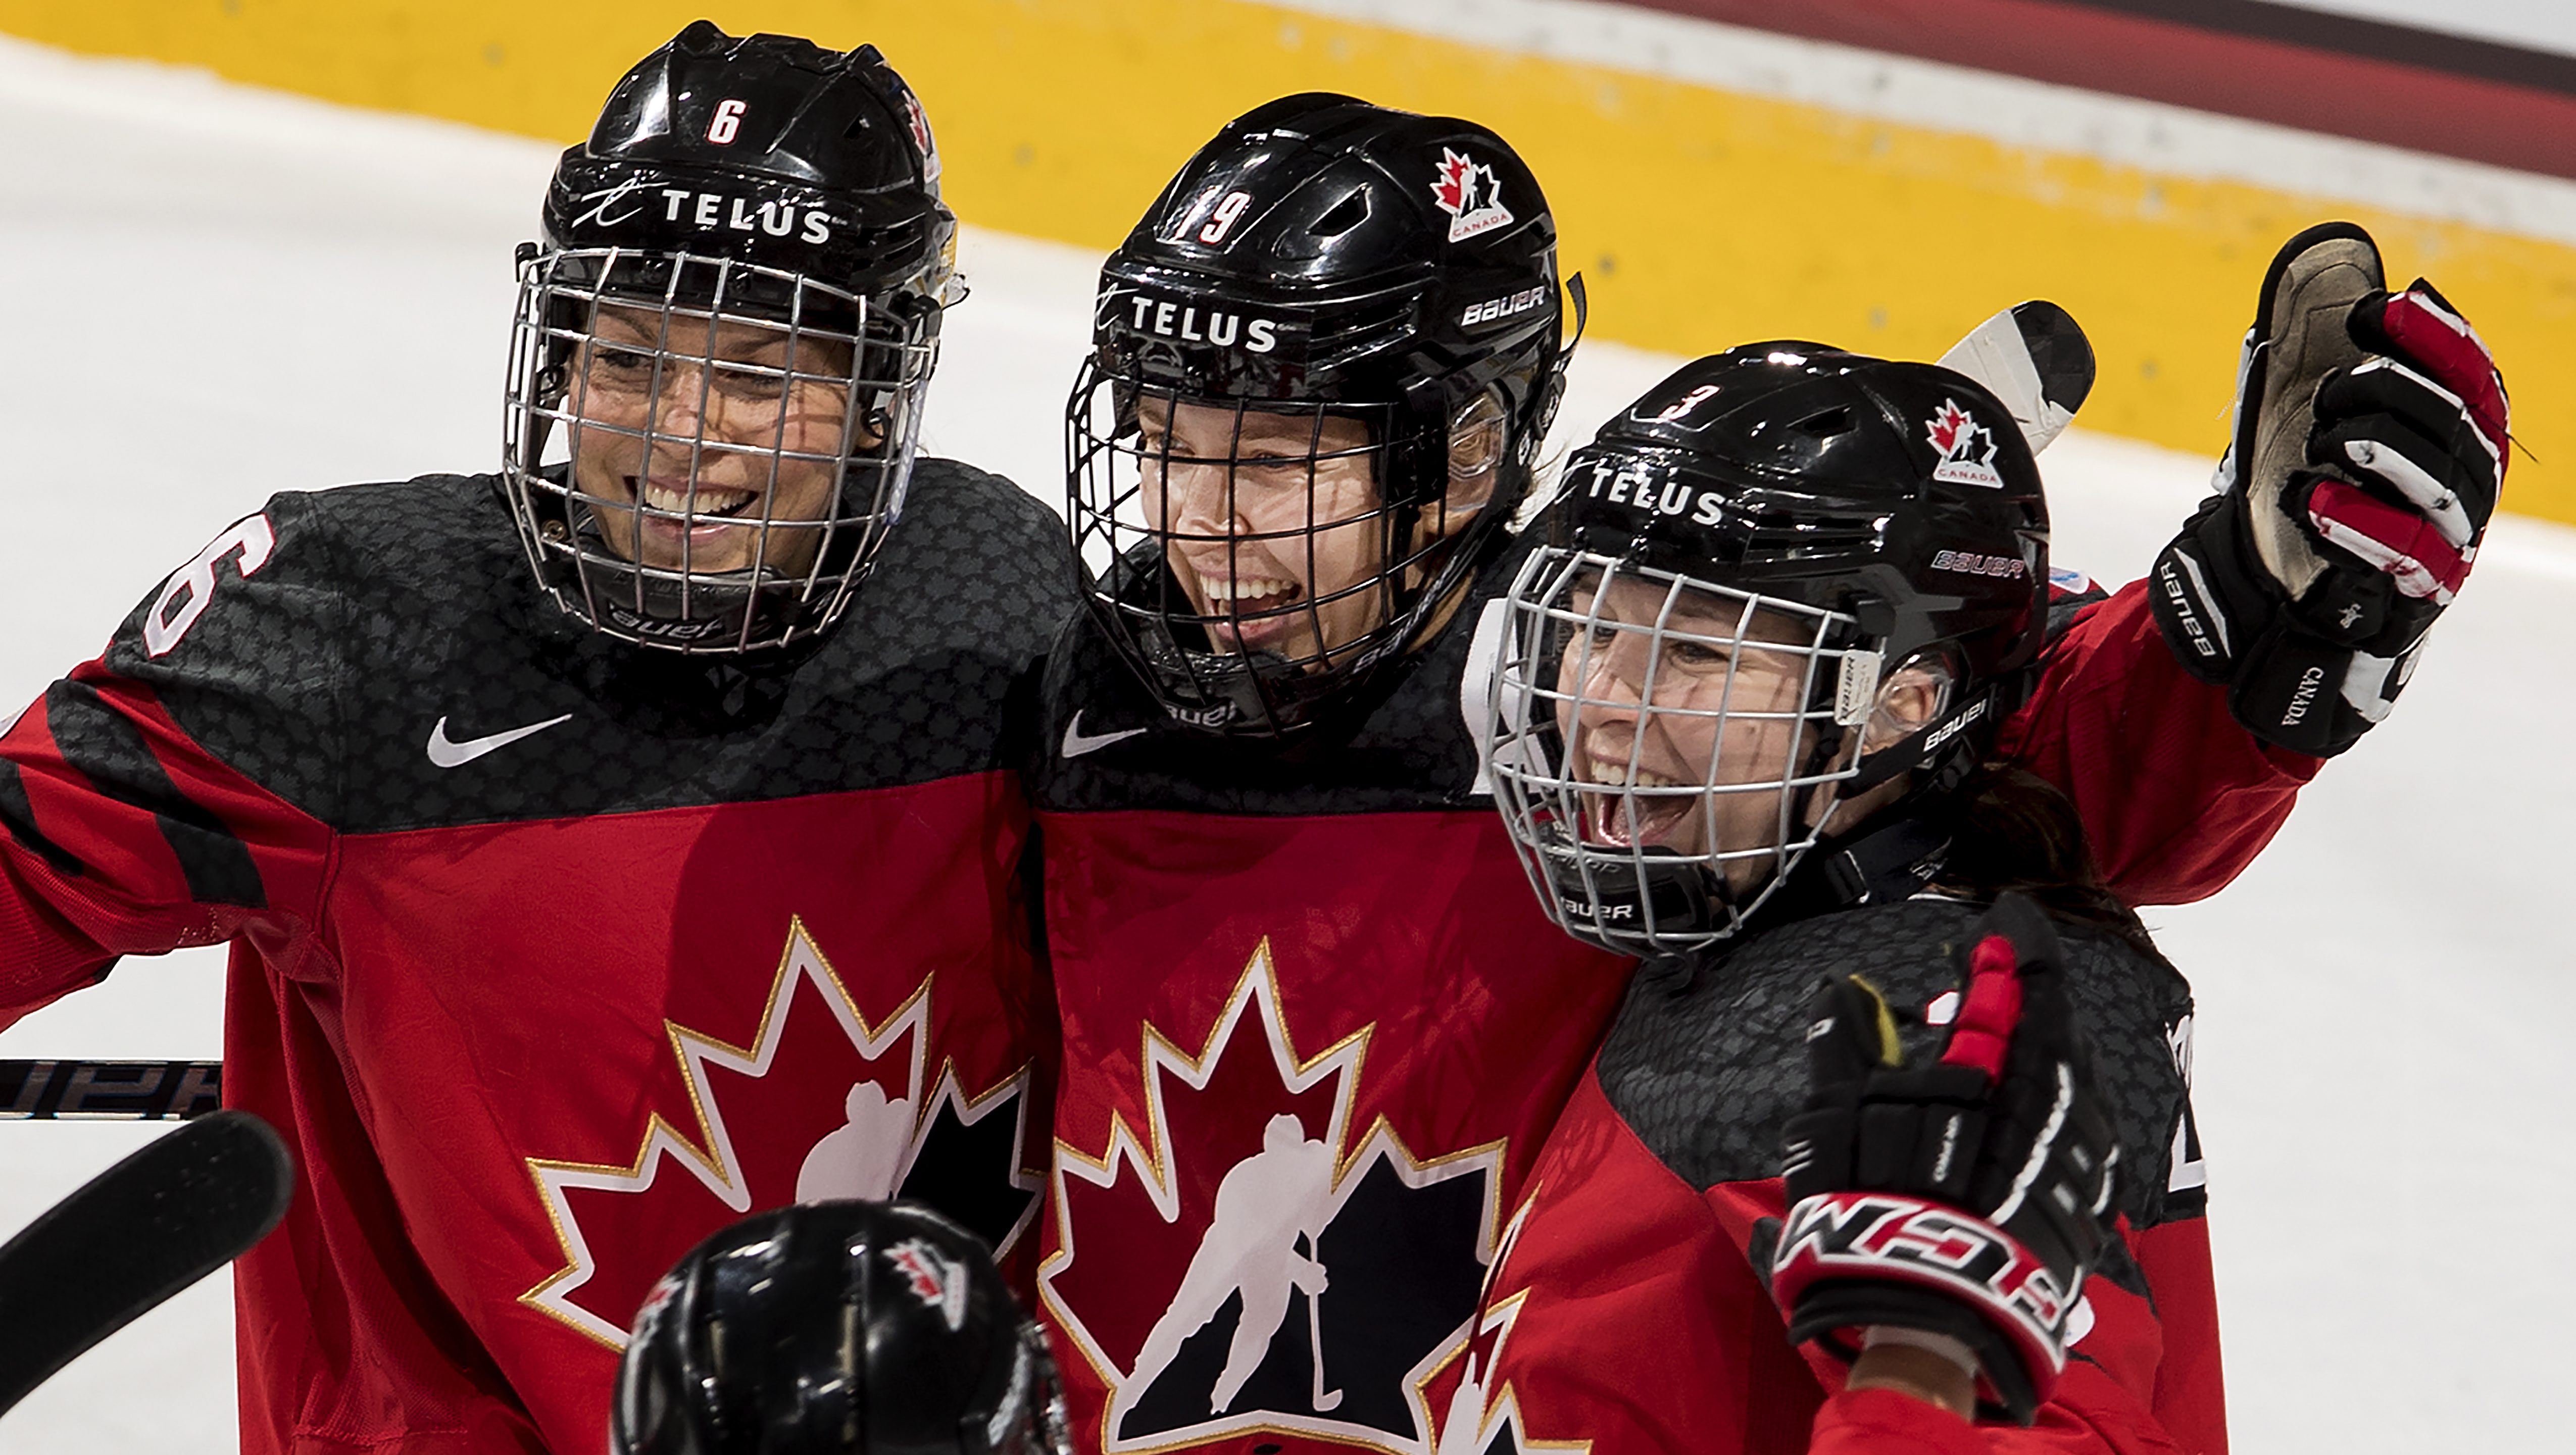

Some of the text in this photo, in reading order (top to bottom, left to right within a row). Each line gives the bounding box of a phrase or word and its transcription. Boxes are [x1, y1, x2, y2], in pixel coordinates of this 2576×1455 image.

[708, 98, 747, 146] 6
[662, 189, 831, 244] TELUS
[1174, 185, 1253, 245] 19
[1452, 213, 1508, 237] CANADA
[1132, 296, 1276, 353] TELUS
[1461, 285, 1546, 327] BAUER
[1655, 383, 1722, 423] 3
[1589, 466, 1726, 526] TELUS
[1938, 469, 1997, 482] CANADA
[143, 513, 276, 659] 6
[1930, 549, 2024, 580] BAUER
[2160, 561, 2216, 657] BAUER
[2281, 666, 2324, 726] CANADA
